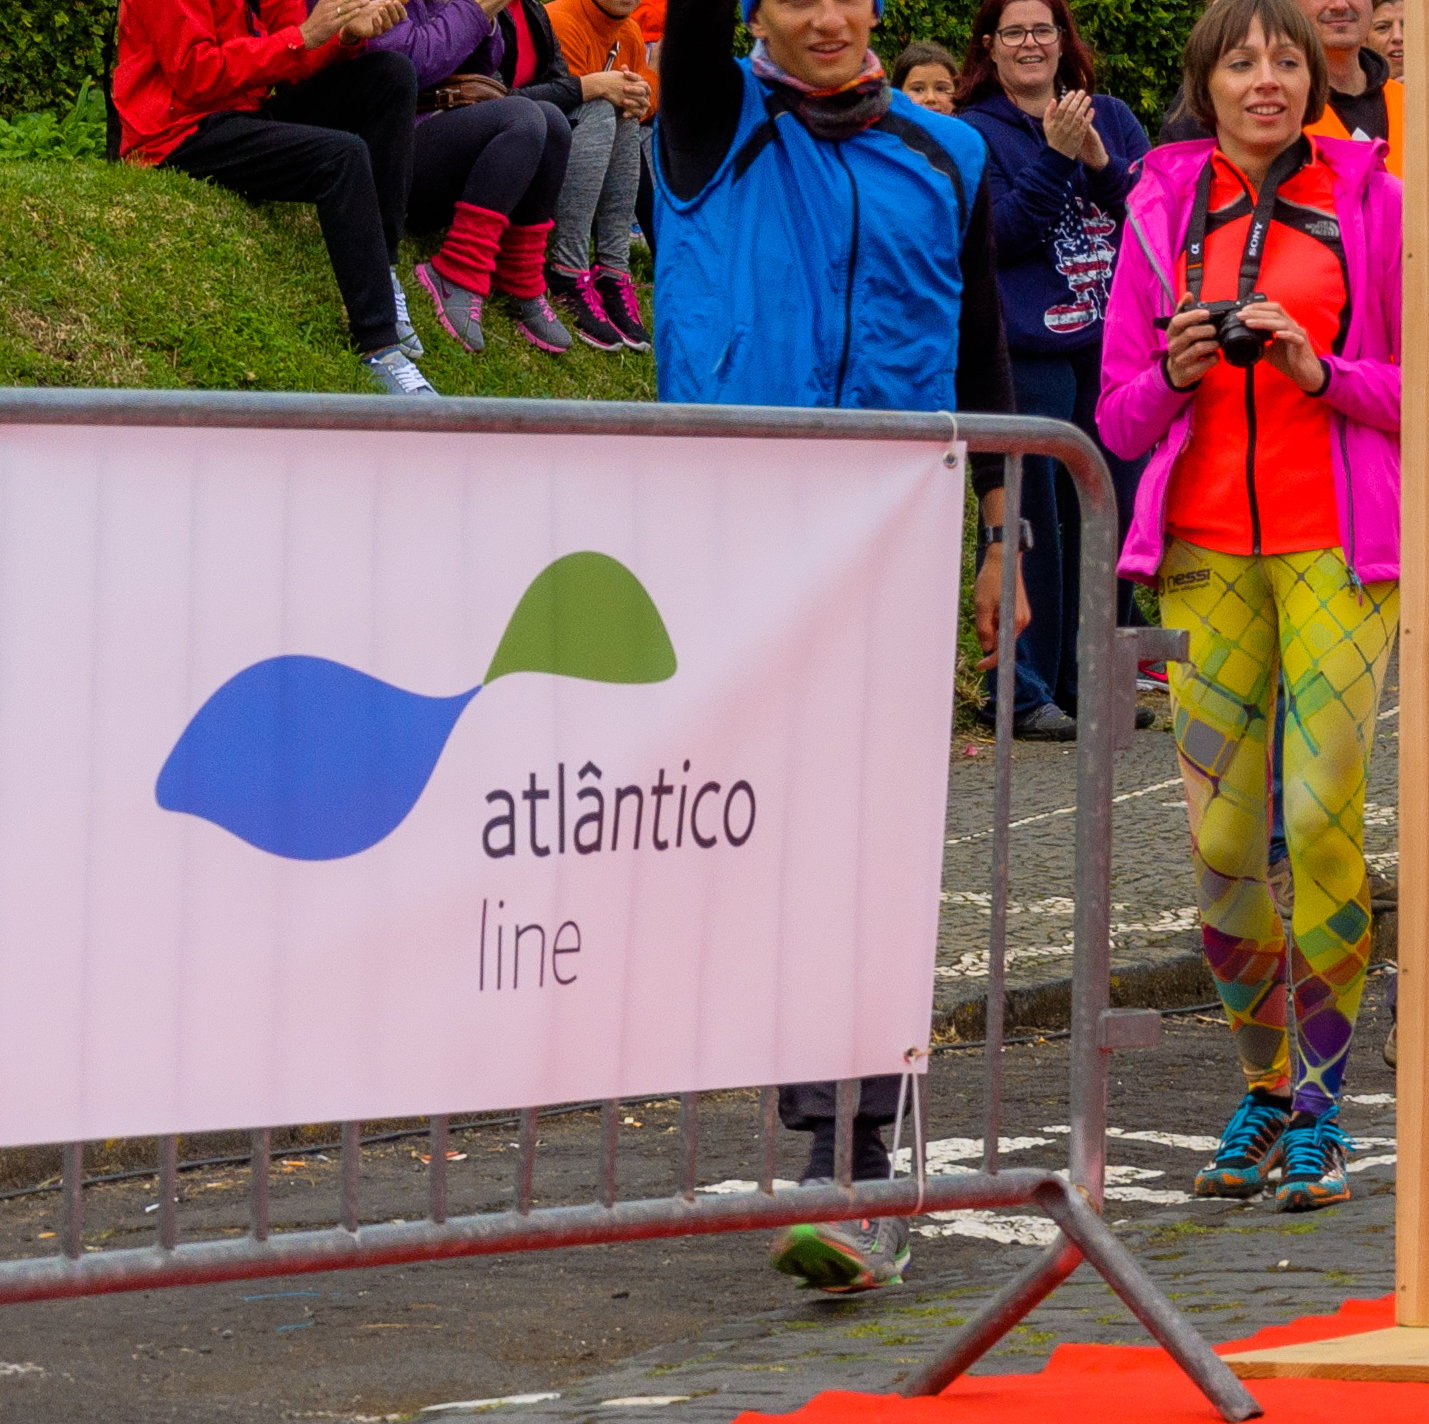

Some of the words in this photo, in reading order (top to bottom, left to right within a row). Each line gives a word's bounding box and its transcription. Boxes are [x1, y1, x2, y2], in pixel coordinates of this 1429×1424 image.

[1249, 221, 1263, 257] SONY
[480, 758, 757, 860] atlântico
[478, 896, 583, 992] line
